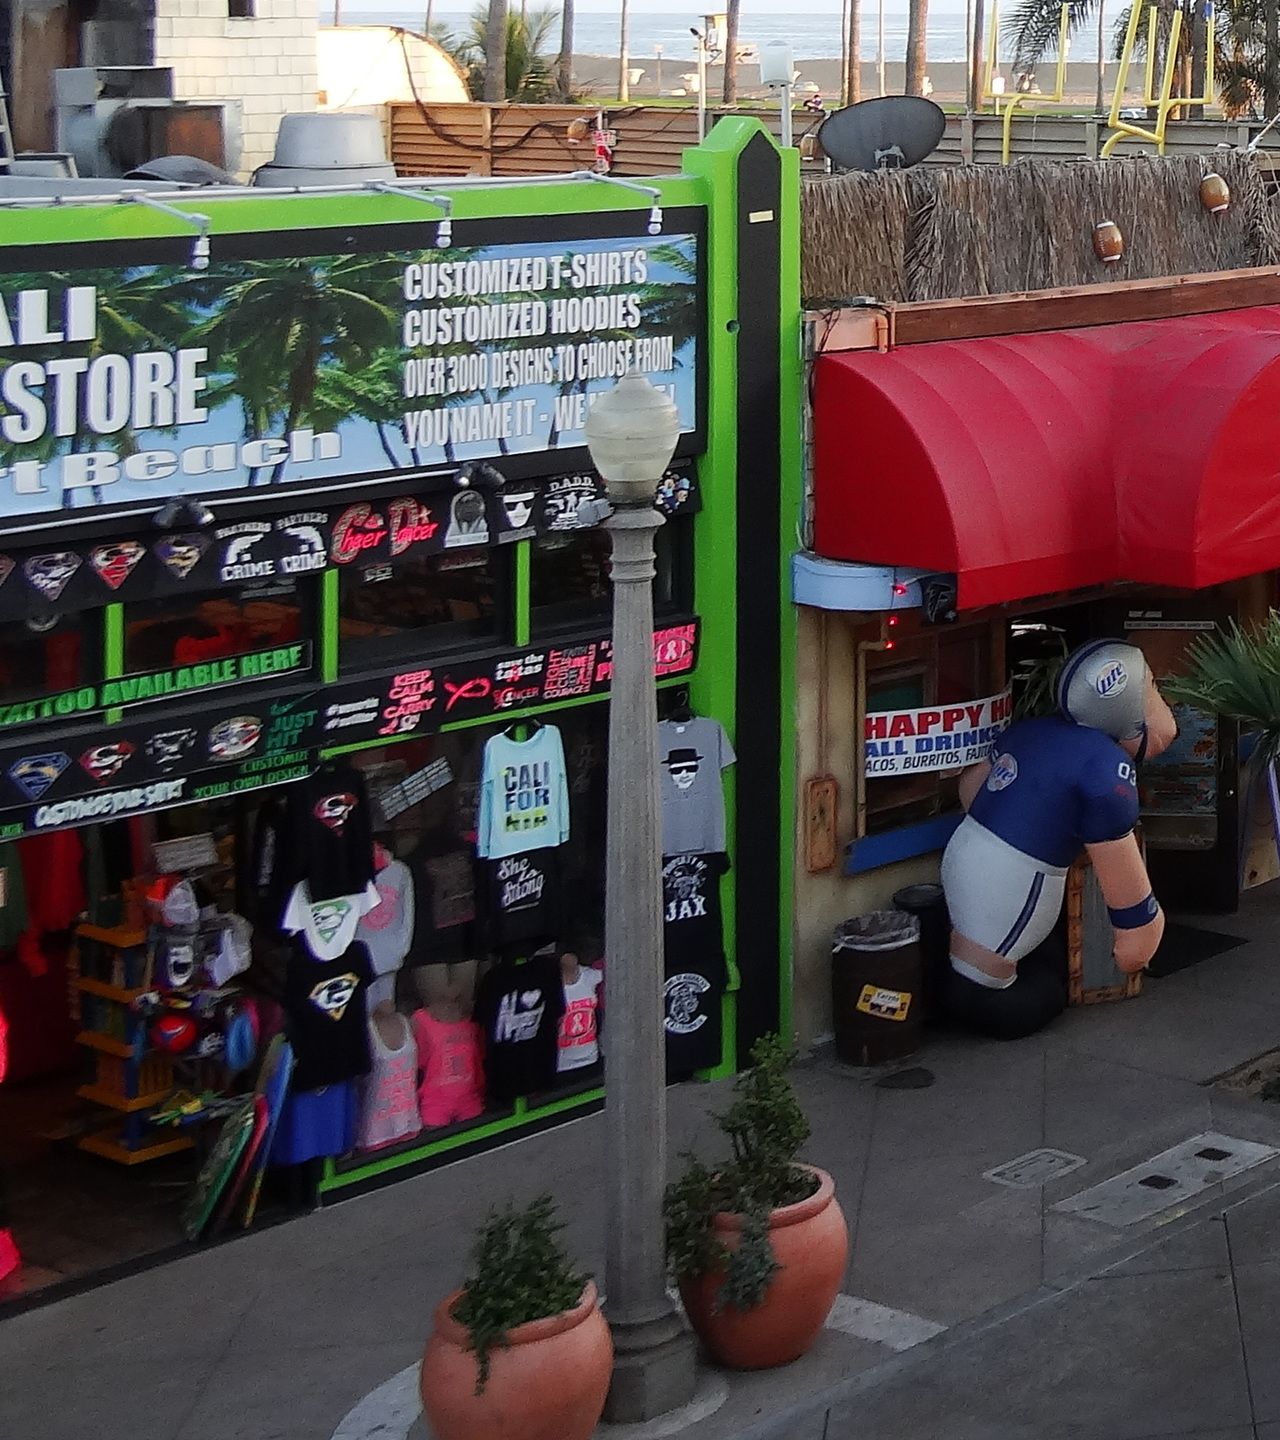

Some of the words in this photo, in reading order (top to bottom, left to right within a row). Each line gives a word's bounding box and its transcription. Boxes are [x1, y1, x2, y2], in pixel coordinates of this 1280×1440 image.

[404, 257, 548, 301] CUSTOMIZED
[550, 249, 648, 290] T-SHIRTS
[404, 301, 548, 347] CUSTOMIZED
[551, 294, 642, 335] HOODIES
[405, 357, 446, 398] OVER
[449, 352, 487, 393] 3000
[492, 346, 554, 388] DESIGNS
[556, 343, 576, 381] TO
[634, 335, 674, 372] FROM
[2, 347, 208, 444] STORE
[404, 407, 448, 449] YOU
[450, 402, 513, 444] NAME
[514, 398, 537, 436] IT
[555, 393, 585, 433] WE
[61, 428, 342, 490] Beach
[221, 559, 275, 582] CRIME
[102, 660, 237, 707] AVAILABLE
[242, 645, 303, 677] HERE
[865, 703, 985, 741] HAPPY
[865, 740, 908, 759] ALL
[865, 757, 898, 773] ACOS,
[903, 750, 962, 772] BURRITOS,
[504, 761, 549, 792] CALI
[505, 788, 549, 812] FOR
[666, 895, 707, 921] JAX
